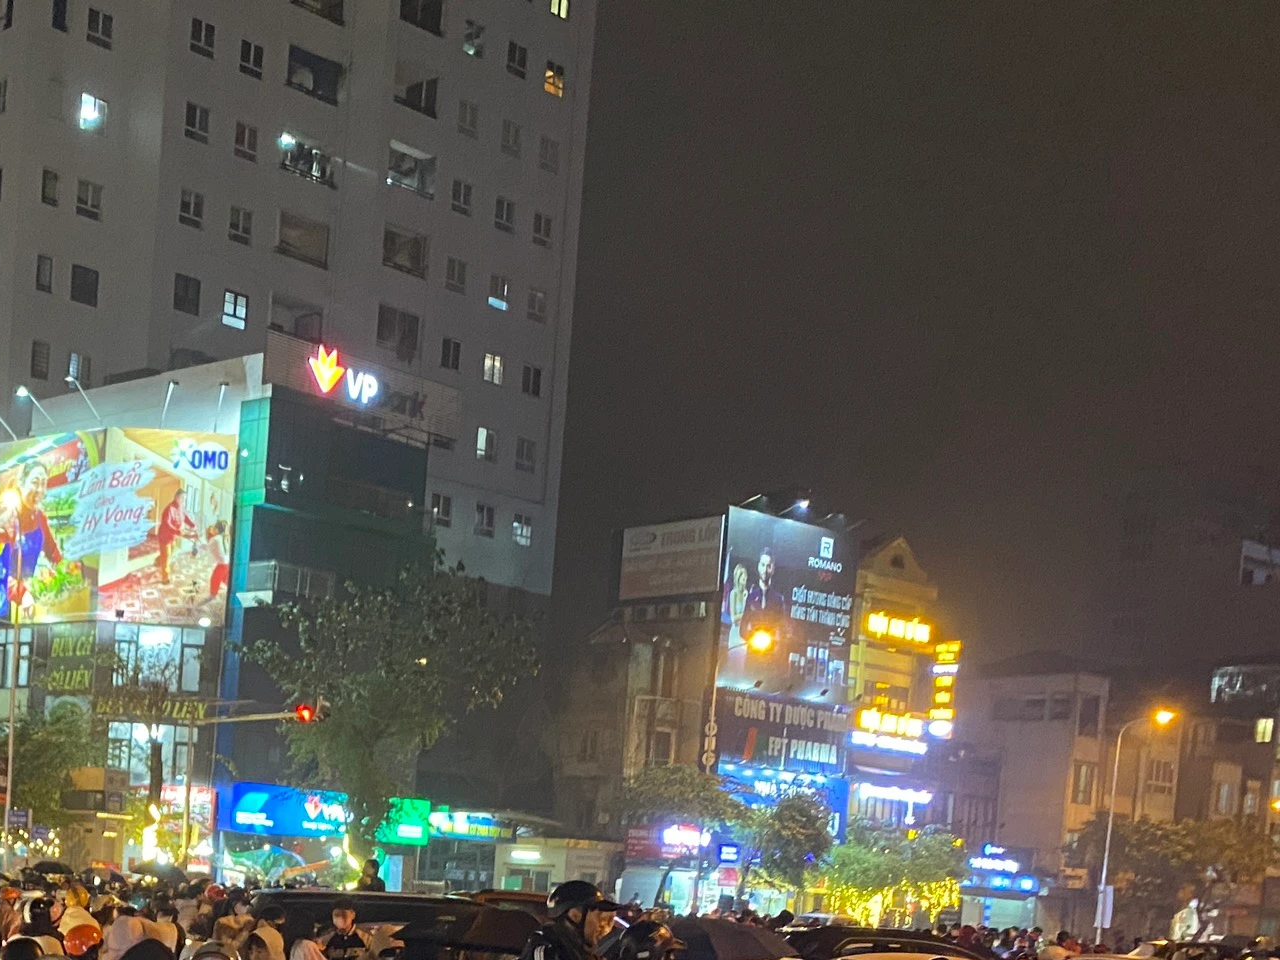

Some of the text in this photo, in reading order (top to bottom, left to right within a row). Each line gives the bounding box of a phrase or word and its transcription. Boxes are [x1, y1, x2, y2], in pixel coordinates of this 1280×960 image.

[192, 450, 229, 470] OMO
[104, 506, 144, 528] Vọng
[808, 556, 842, 573] ROMANO
[735, 695, 767, 720] CÔNG
[769, 702, 784, 723] TY
[789, 739, 838, 765] PHARMA
